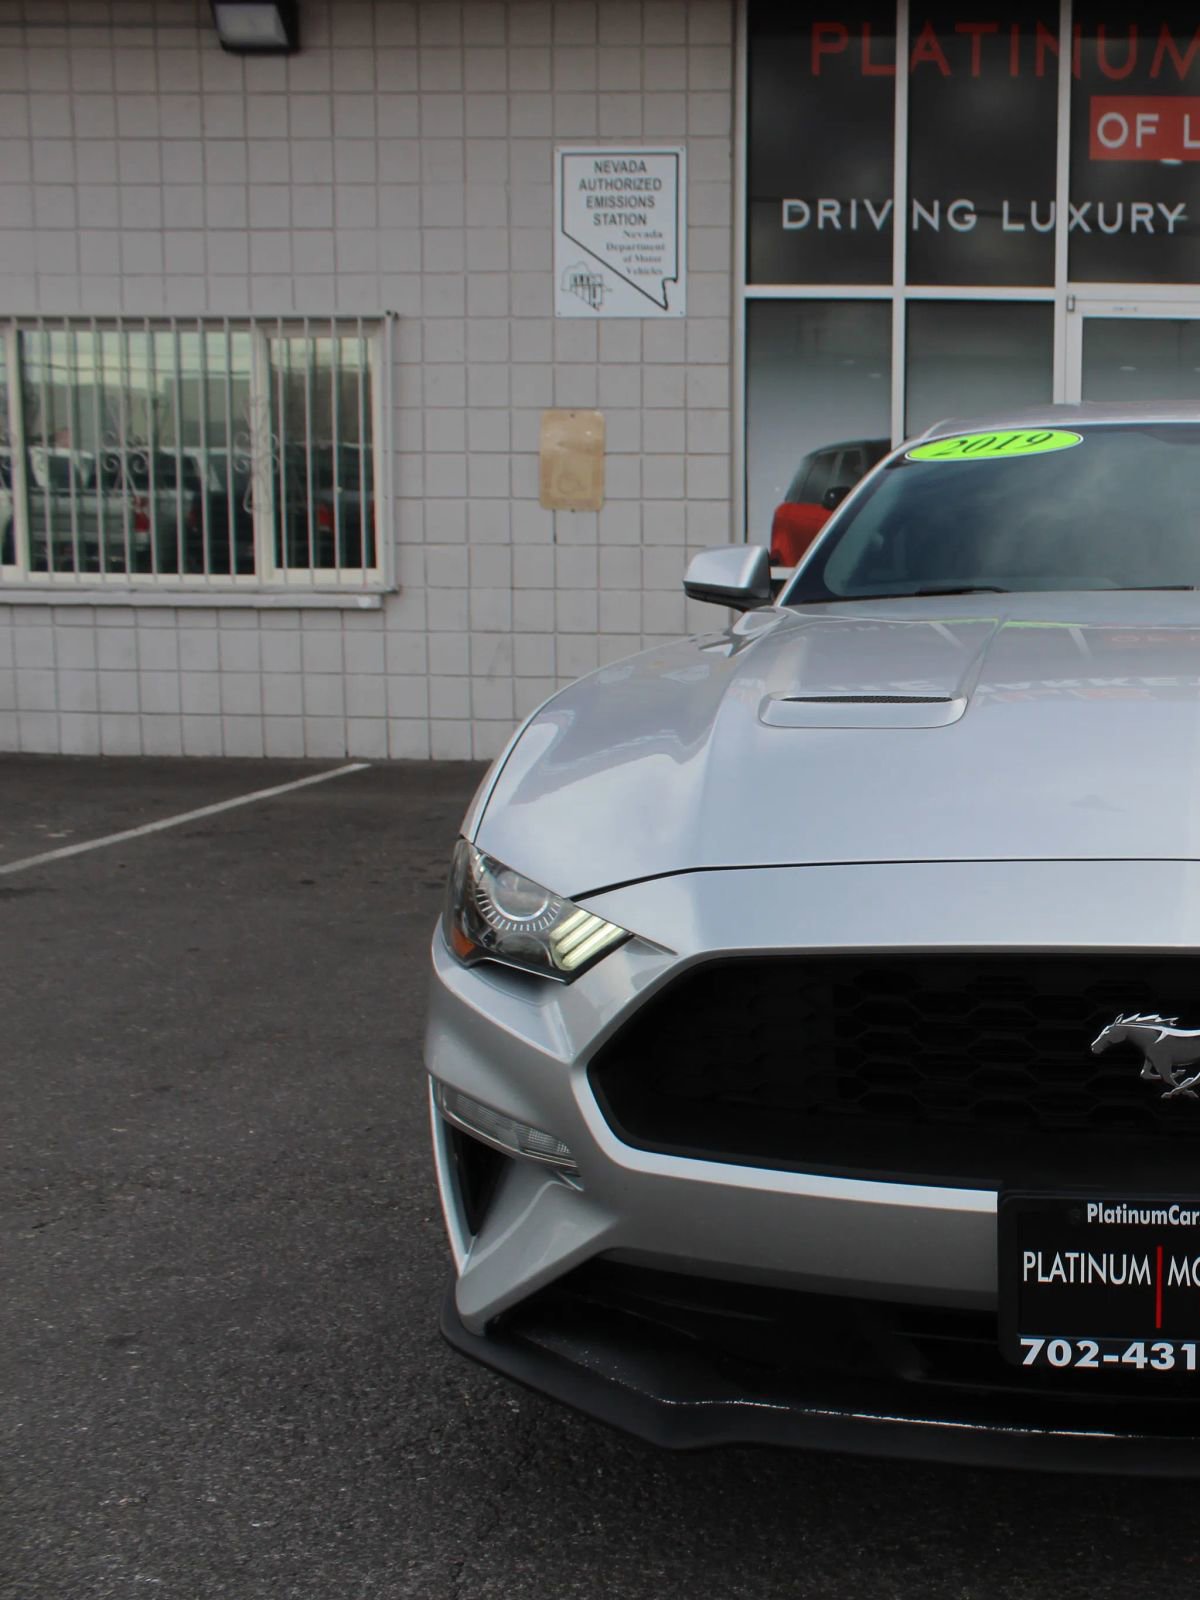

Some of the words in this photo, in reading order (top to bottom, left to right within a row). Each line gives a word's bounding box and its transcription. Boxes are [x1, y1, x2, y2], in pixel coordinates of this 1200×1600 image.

[1097, 112, 1159, 148] OF
[593, 160, 647, 173] NEVADA
[578, 178, 662, 191] AUTHORIZED
[586, 195, 655, 208] EMISSIONS
[593, 213, 647, 226] STATION
[782, 199, 978, 232] DRIVNG
[1003, 201, 1186, 235] LUXURY
[929, 432, 1055, 457] 2019
[1023, 1251, 1151, 1286] PLATINUM
